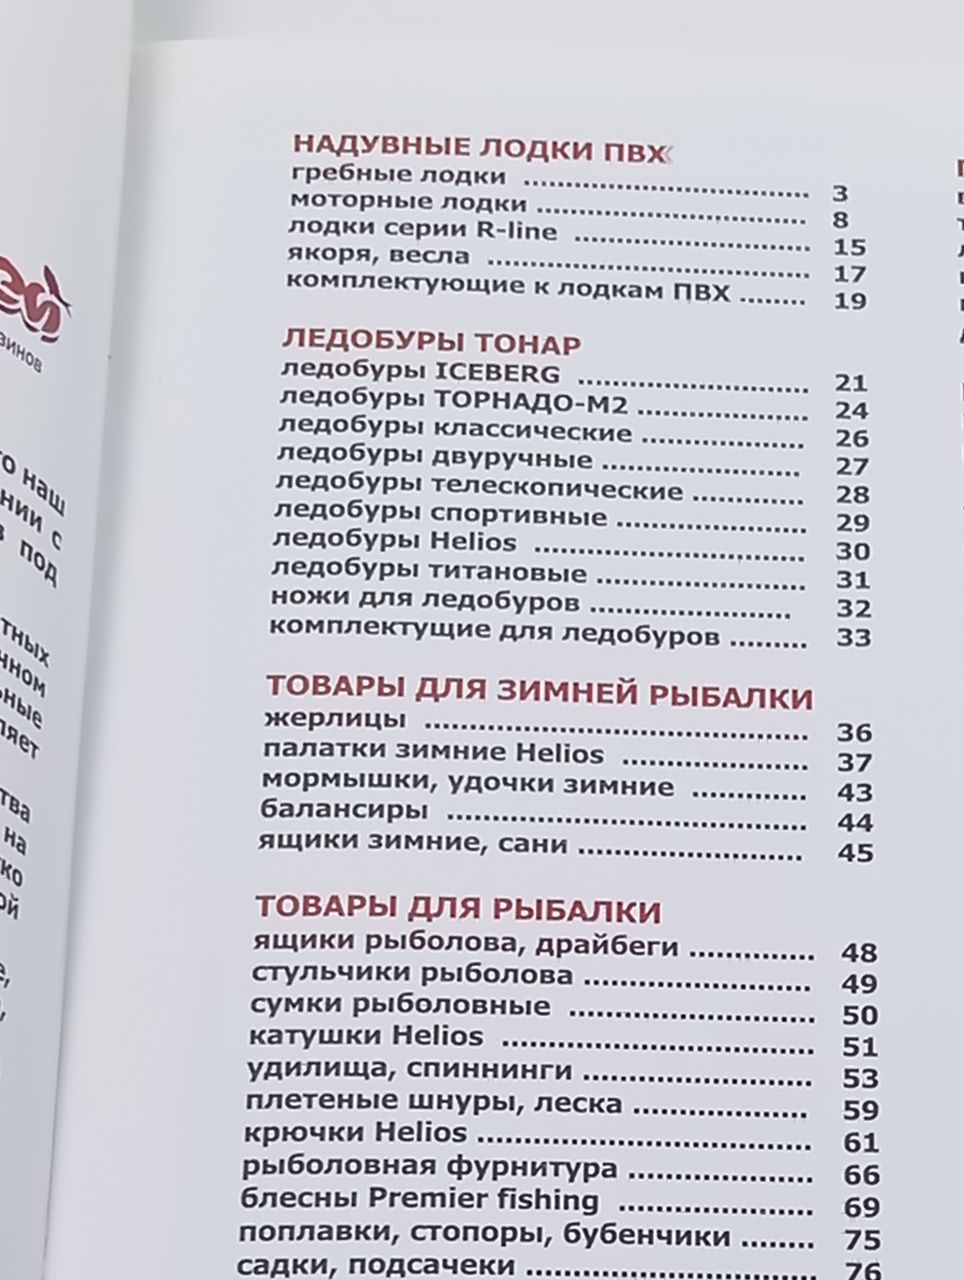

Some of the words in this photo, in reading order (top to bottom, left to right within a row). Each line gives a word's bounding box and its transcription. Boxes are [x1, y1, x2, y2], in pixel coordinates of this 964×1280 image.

[293, 133, 471, 158] НАДУВНЫЕ
[479, 137, 593, 164] ЛОДКИ
[604, 142, 670, 165] ПВХ
[291, 162, 413, 185] гребные
[419, 168, 506, 187] лодки
[832, 184, 849, 203] 3
[287, 219, 375, 238] лодки
[383, 221, 467, 241] серии
[476, 219, 558, 242] R-line
[834, 237, 867, 257] 15
[281, 327, 465, 353] ЛЕДОБУРЫ
[473, 332, 582, 357] ТОНАР
[279, 385, 425, 411] ледобуры
[433, 388, 629, 416] ТОРНАДО-М2
[835, 400, 870, 421] 24
[276, 441, 423, 467] ледобуры
[431, 449, 593, 472] двуручные
[835, 456, 870, 476] 27
[22, 467, 65, 518] наш
[273, 498, 421, 524] ледобуры
[430, 506, 608, 528] спортивные
[836, 513, 870, 533] 29
[51, 530, 62, 551] с
[271, 527, 420, 553] ледобуры
[430, 530, 517, 553] Helios
[835, 541, 871, 562] 30
[20, 539, 57, 588] под
[271, 589, 350, 606] ножи
[358, 590, 413, 609] для
[421, 589, 581, 616] ледобуров
[836, 598, 873, 619] 32
[265, 673, 405, 698] ТОВАРЫ
[414, 676, 487, 704] ДЛЯ
[496, 678, 638, 706] ЗИМНЕЙ
[650, 684, 813, 711] РЫБАЛКИ
[263, 711, 406, 732] жерлицы
[836, 722, 873, 743] 36
[262, 771, 438, 795] мормышки,
[447, 774, 555, 796] удочки
[563, 777, 675, 797] зимние
[837, 782, 873, 803] 43
[4, 826, 26, 856] на
[257, 832, 359, 853] ящики
[367, 833, 489, 857] зимние,
[498, 836, 568, 855] сани
[837, 842, 874, 863] 45
[254, 894, 398, 918] ТОВАРЫ
[407, 895, 481, 923] ДЛЯ
[493, 897, 661, 925] РЫБАЛКИ
[251, 964, 411, 987] стульчики
[420, 961, 574, 988] рыболова
[841, 973, 878, 995] 49
[249, 1028, 382, 1051] катушки
[392, 1023, 484, 1047] Helios
[842, 1036, 879, 1058] 51
[245, 1092, 399, 1110] плетеные
[408, 1093, 525, 1117] шнуры,
[533, 1095, 623, 1115] леска
[843, 1099, 880, 1122] 59
[242, 1152, 437, 1182] рыболовная
[446, 1153, 618, 1184] фурнитура
[843, 1163, 881, 1186] 66
[238, 1223, 401, 1247] поплавки,
[410, 1224, 553, 1249] стопоры,
[563, 1221, 731, 1250] бубенчики
[843, 1228, 882, 1251] 75
